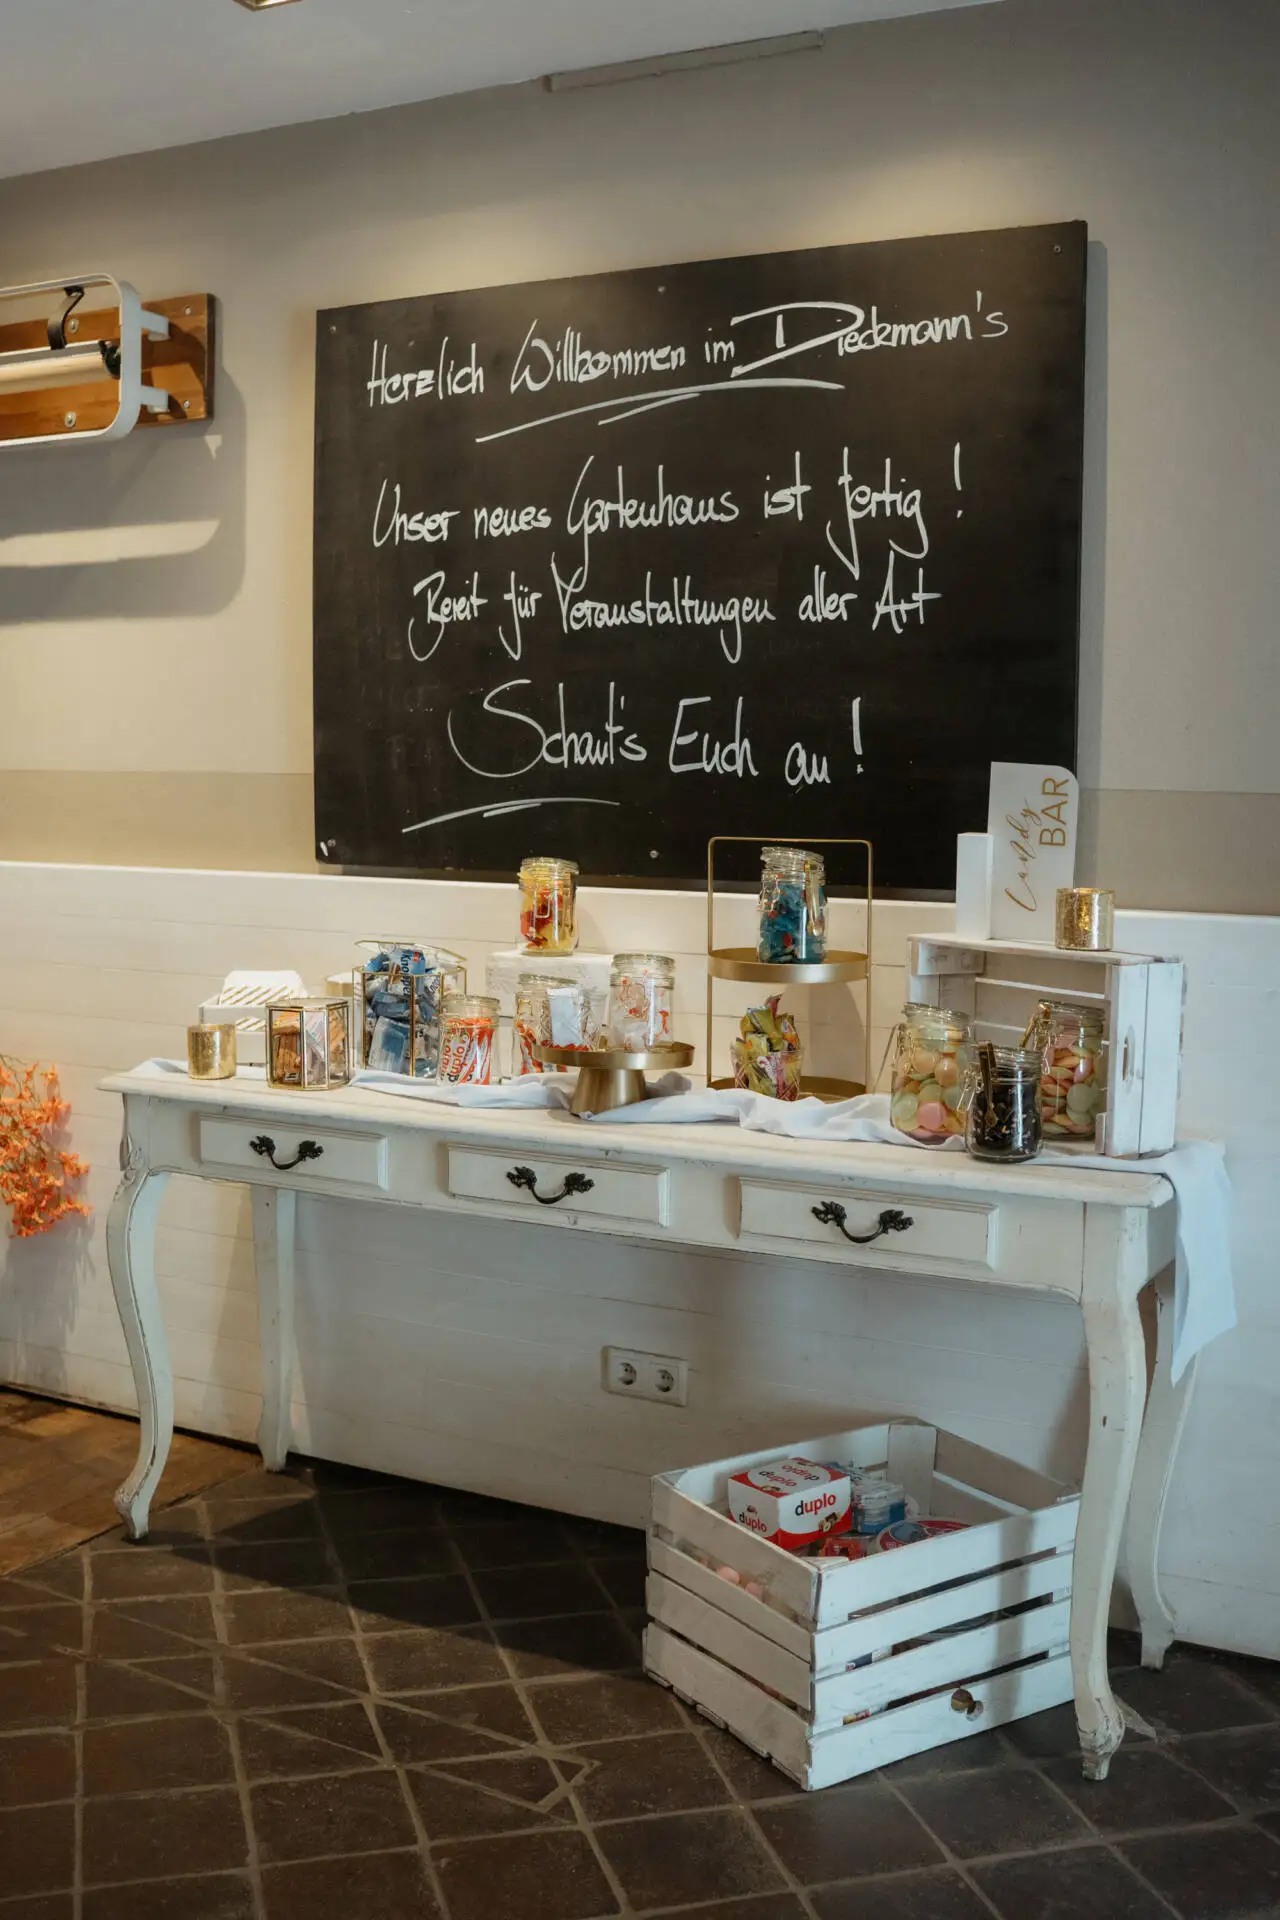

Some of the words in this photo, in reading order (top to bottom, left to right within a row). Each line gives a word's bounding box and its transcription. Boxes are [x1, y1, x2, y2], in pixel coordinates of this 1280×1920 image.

[366, 336, 485, 408] Herzlich
[510, 319, 687, 394] Willkommen
[704, 327, 736, 364] im
[730, 291, 1009, 379] Dieckmann's
[372, 478, 461, 548] Unser
[474, 506, 553, 540] neues
[566, 455, 740, 593] Gartenhaus
[763, 450, 812, 521] ist
[408, 570, 489, 662] Bereit
[499, 570, 543, 661] für
[550, 551, 777, 664] Veranstaltungen
[798, 564, 859, 623] aller
[871, 549, 942, 634] Art
[447, 678, 648, 778] Schaut's
[669, 695, 760, 778] Euch
[1004, 797, 1042, 912] Candy
[1039, 777, 1070, 847] BAR
[448, 1045, 468, 1083] duplo
[758, 1470, 797, 1487] duplo
[795, 1492, 837, 1516] duplo
[738, 1511, 768, 1533] duplo
